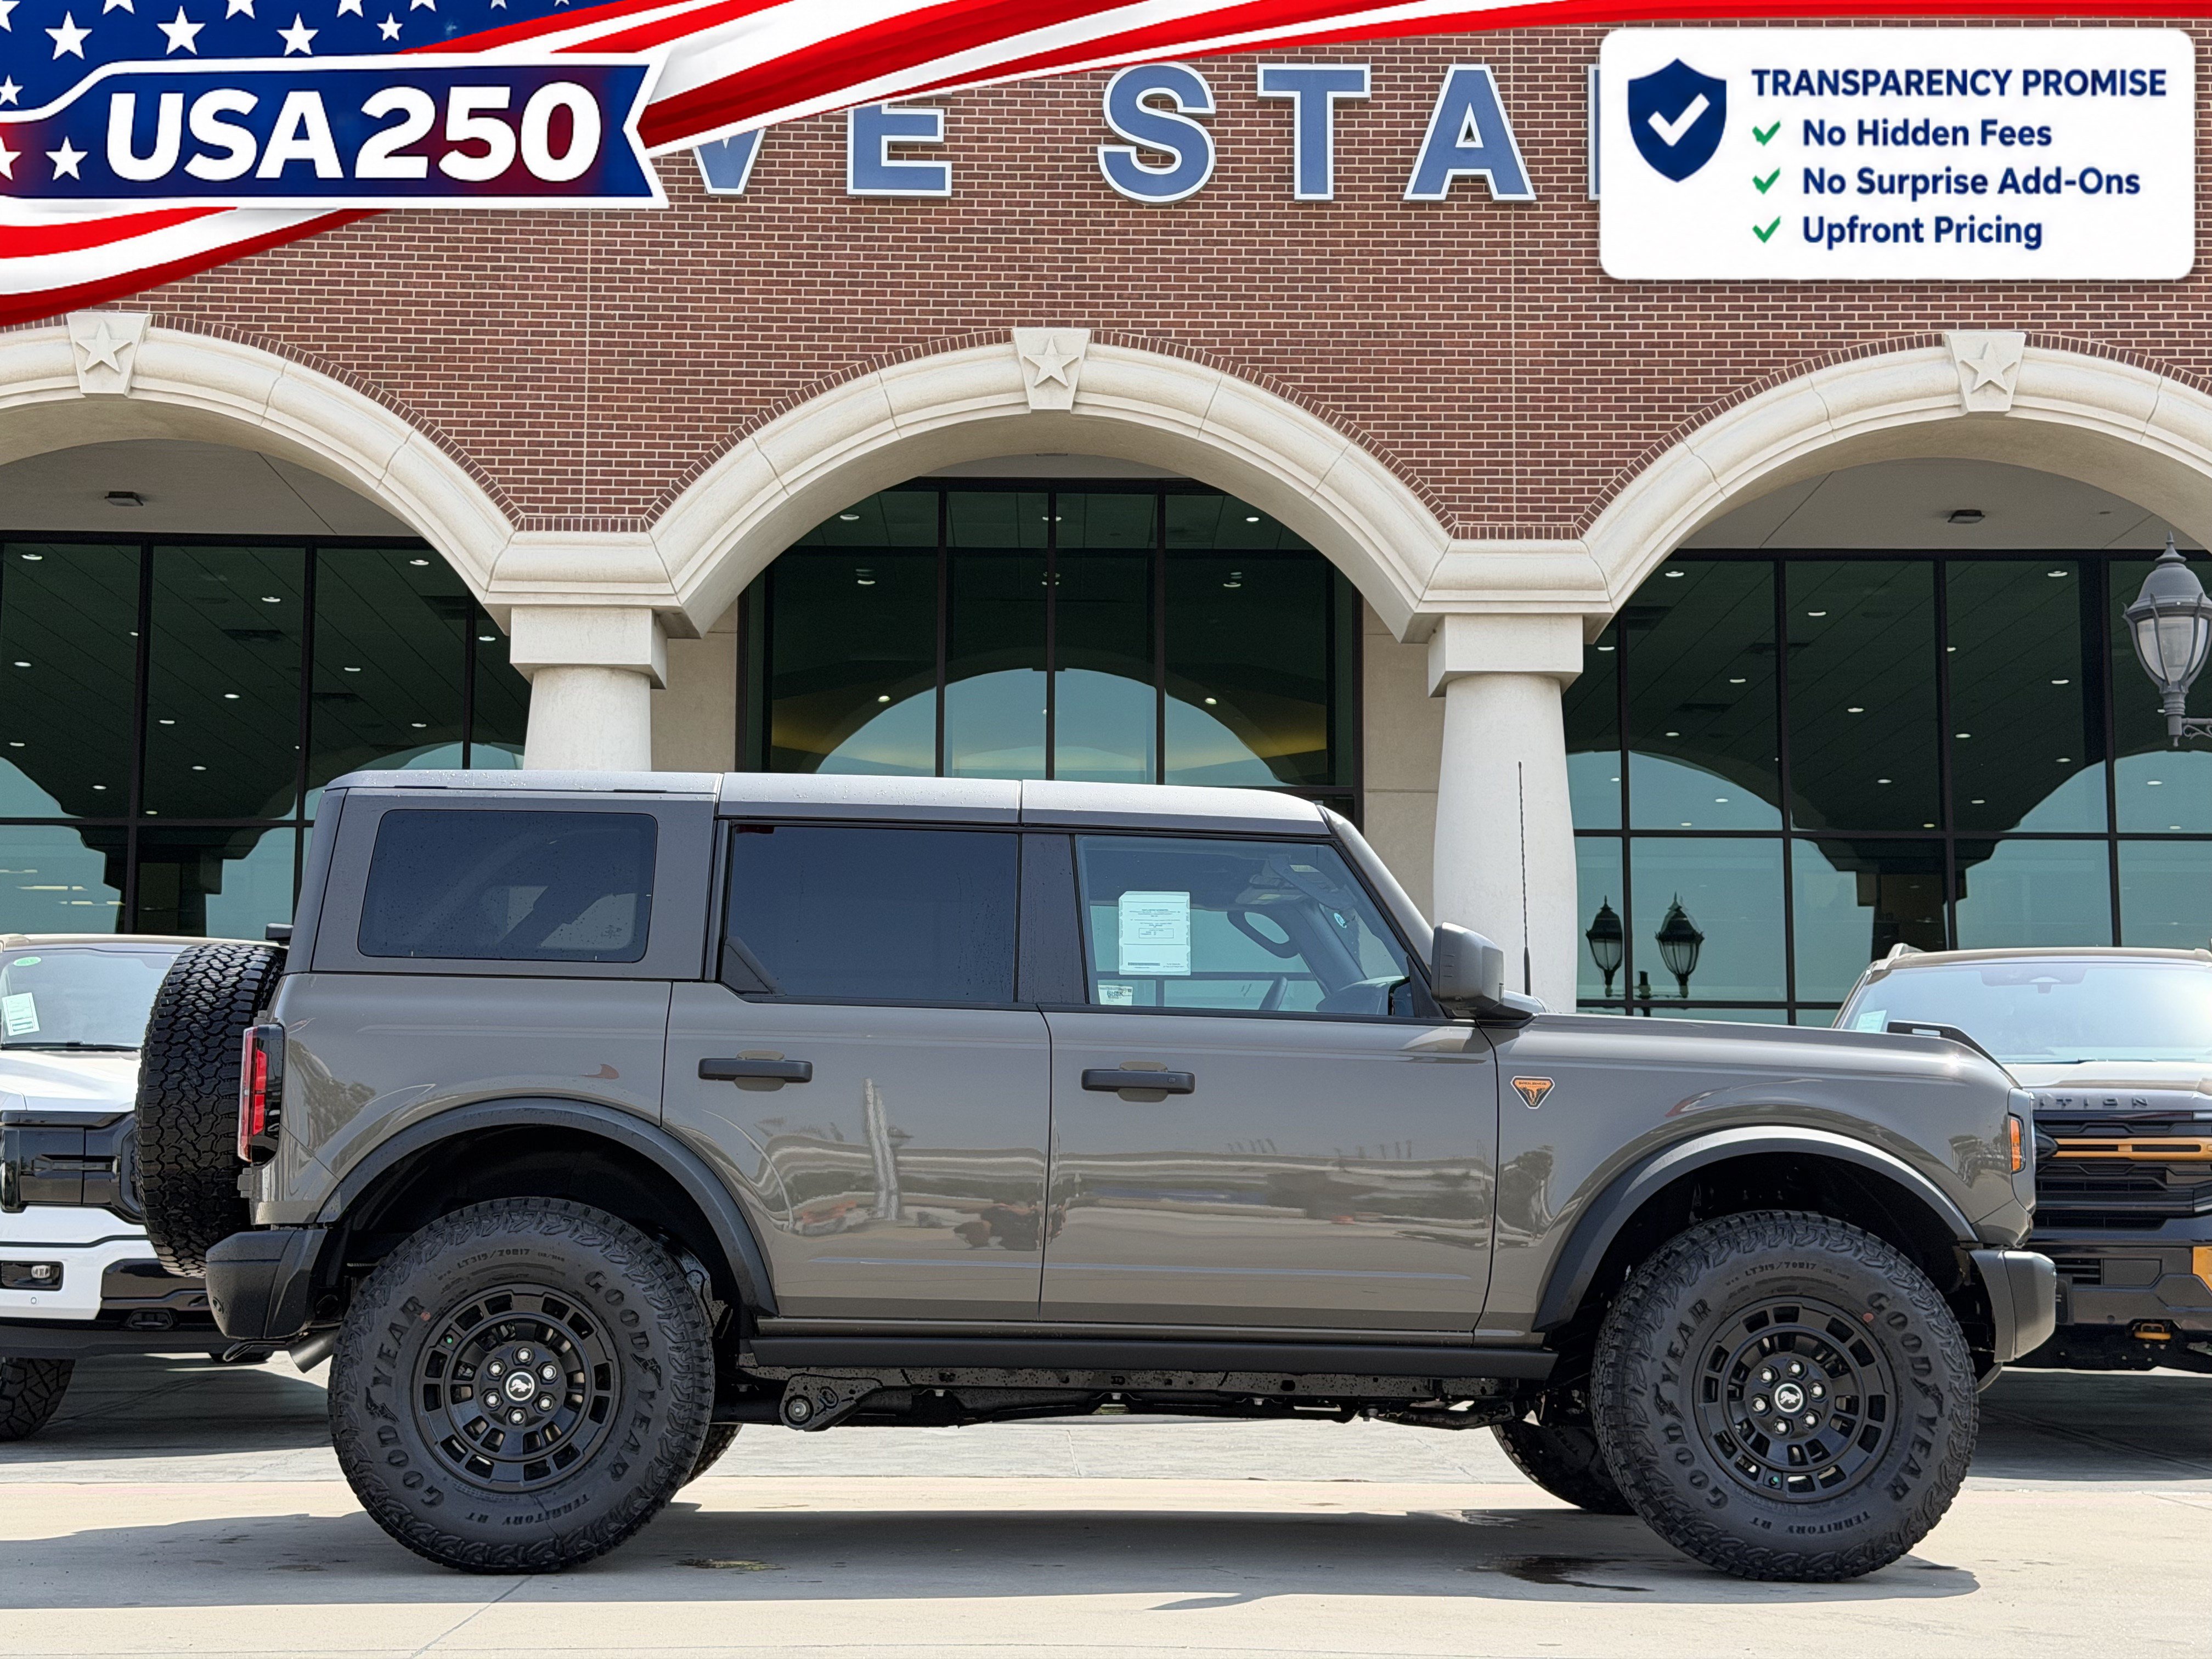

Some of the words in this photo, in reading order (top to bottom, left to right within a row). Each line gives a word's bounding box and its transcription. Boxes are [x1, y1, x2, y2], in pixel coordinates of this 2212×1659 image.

[1098, 60, 1601, 204] STA
[501, 1493, 590, 1526] TERRITORY
[1786, 1510, 1871, 1534] TERRITORY
